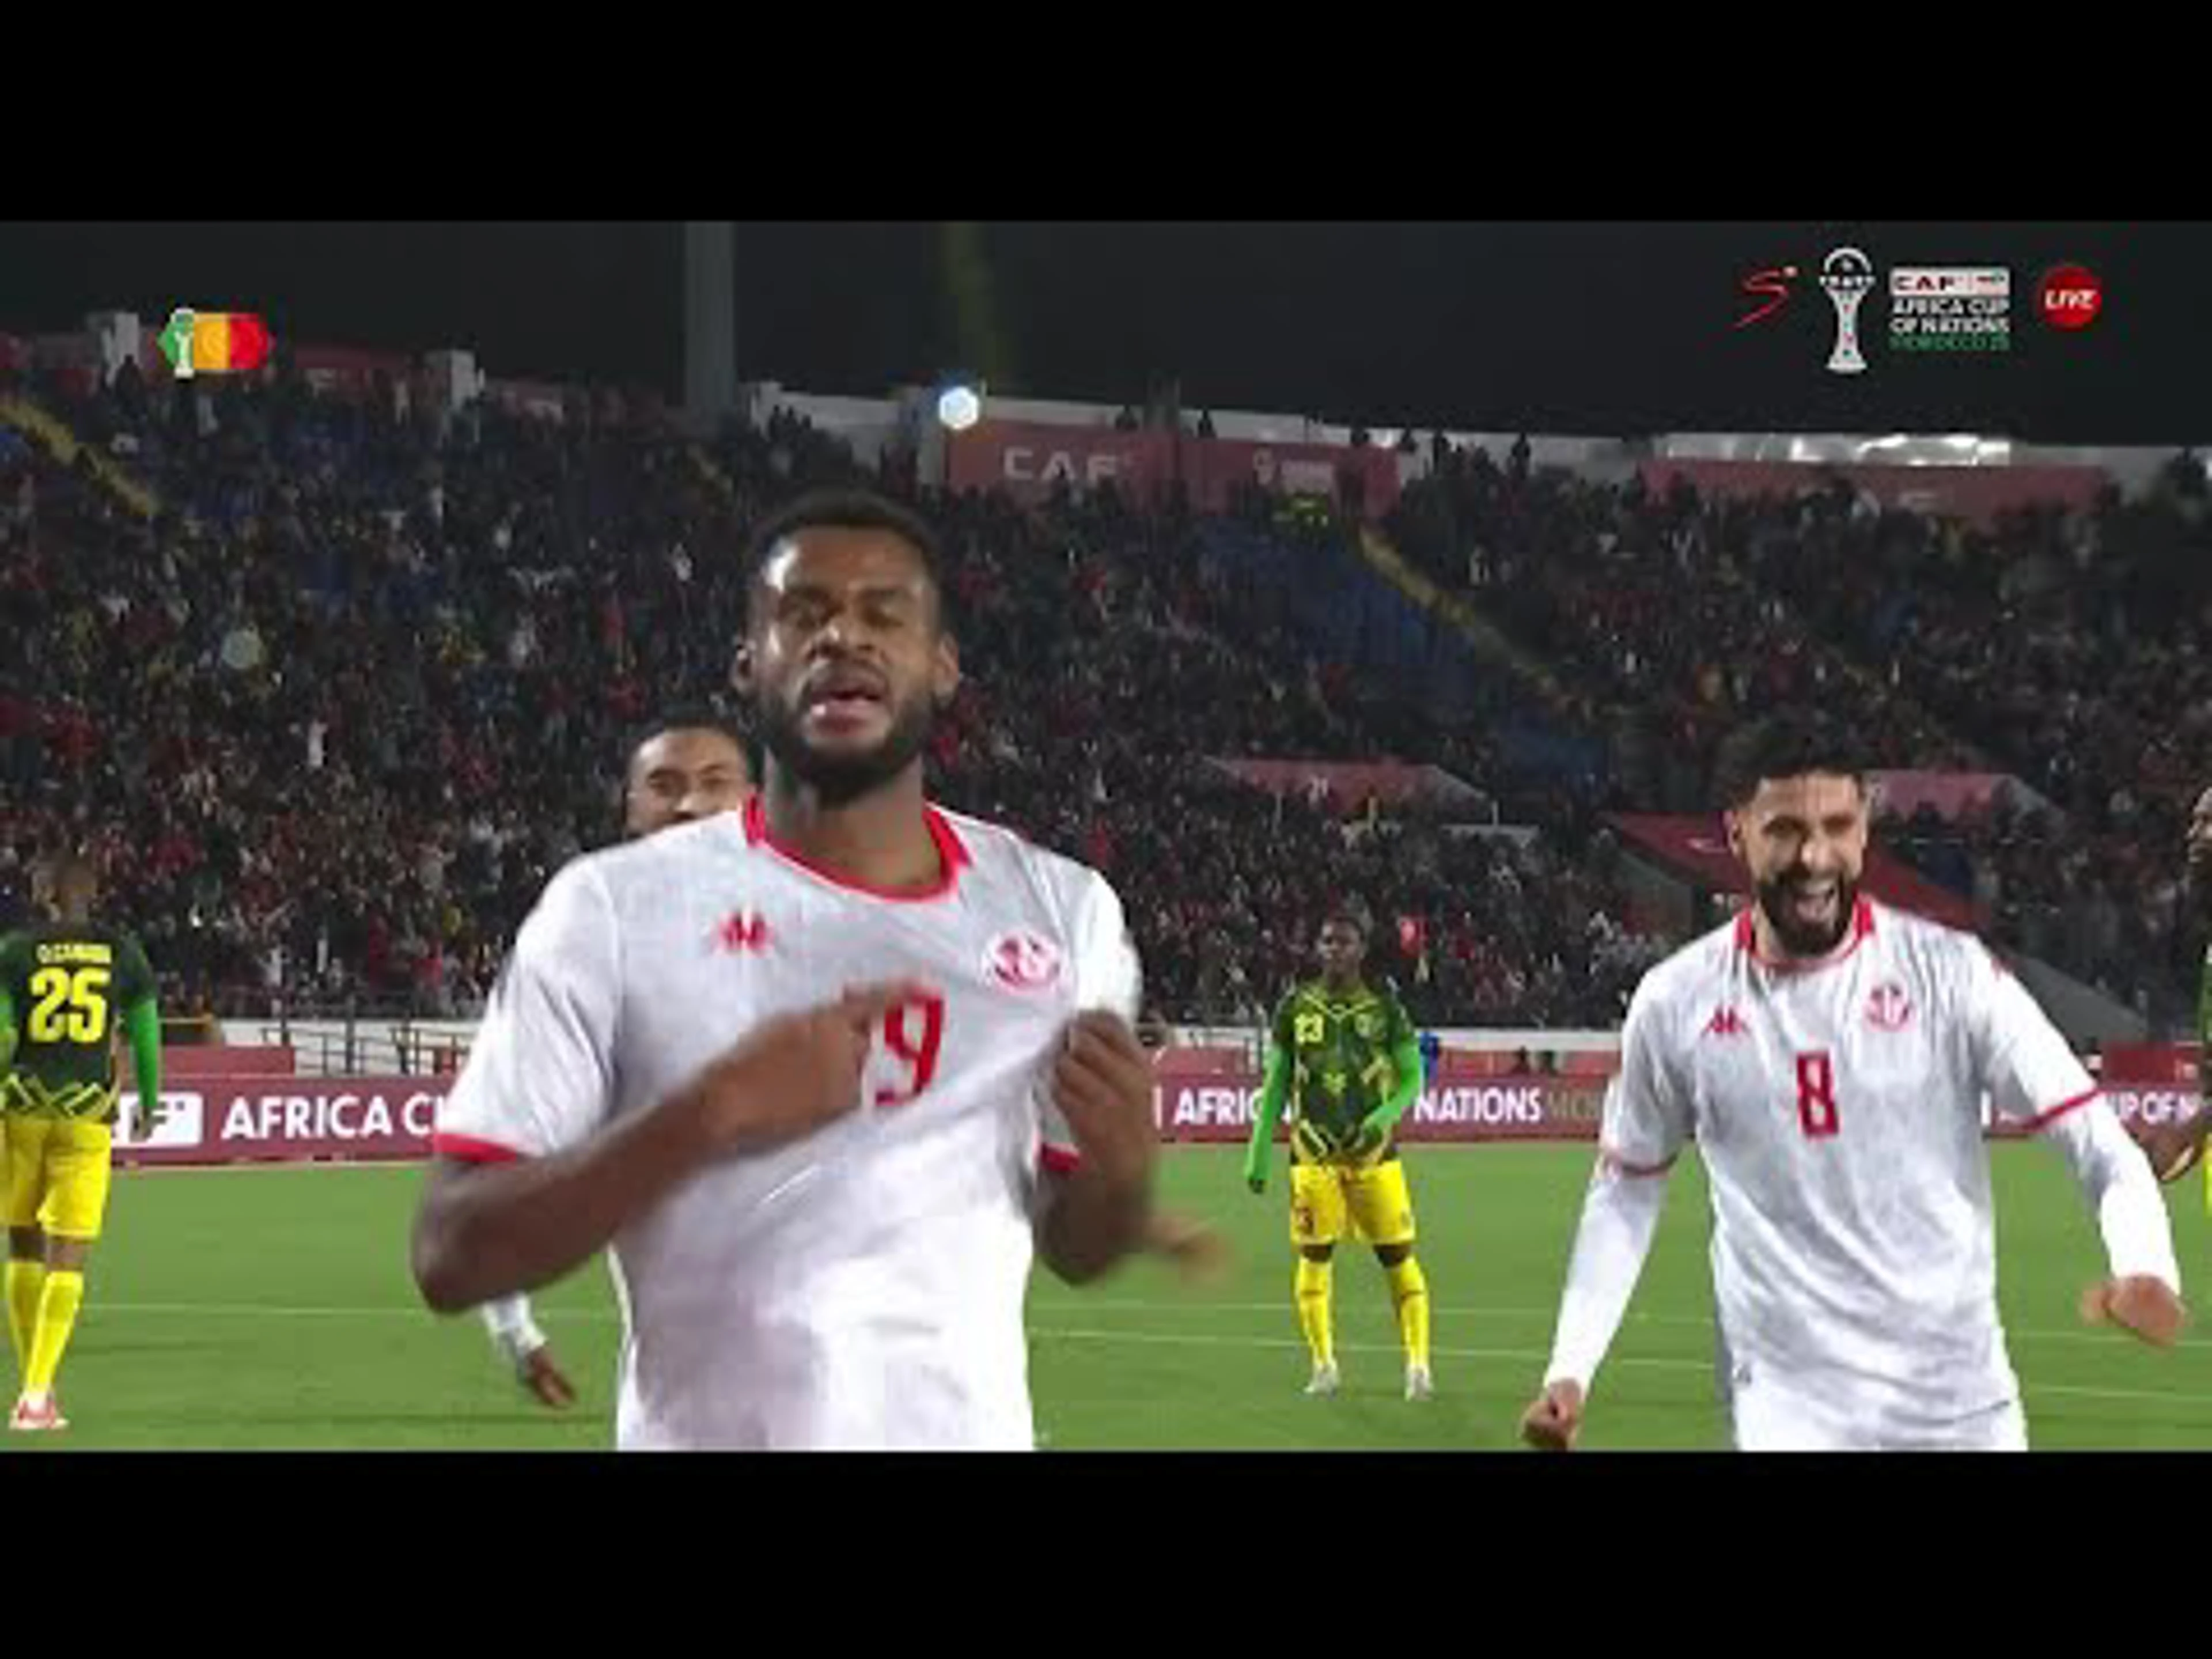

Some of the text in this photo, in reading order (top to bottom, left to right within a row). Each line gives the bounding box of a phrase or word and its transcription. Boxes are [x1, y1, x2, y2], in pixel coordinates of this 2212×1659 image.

[1003, 446, 1118, 485] CAF
[30, 967, 111, 1043] 25
[1294, 1012, 1324, 1044] 23
[1414, 1086, 1542, 1122] NATIONS
[1796, 1049, 1839, 1139] 8
[220, 1094, 393, 1139] AFRICA
